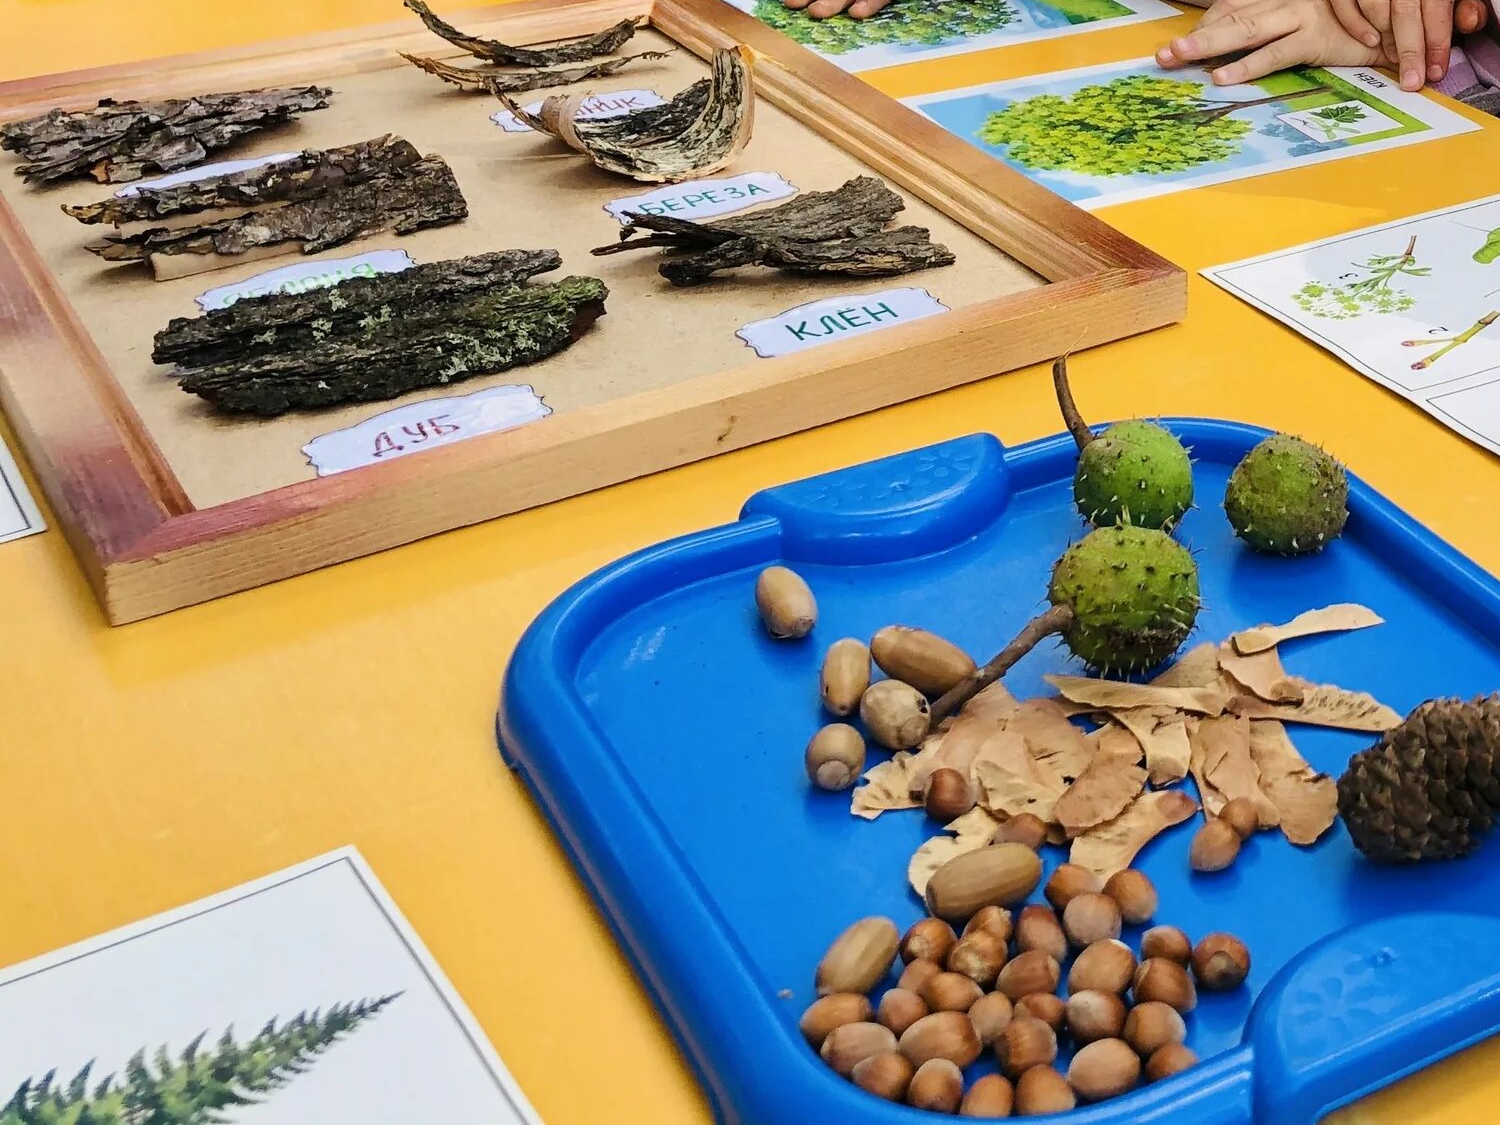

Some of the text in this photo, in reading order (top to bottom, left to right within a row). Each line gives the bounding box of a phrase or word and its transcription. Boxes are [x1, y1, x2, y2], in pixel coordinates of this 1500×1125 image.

[638, 183, 770, 216] БЕРЕЗА
[1339, 272, 1359, 280] 3
[784, 302, 899, 341] КЛЁН
[1428, 326, 1449, 335] 2
[373, 414, 460, 457] ДУБ
